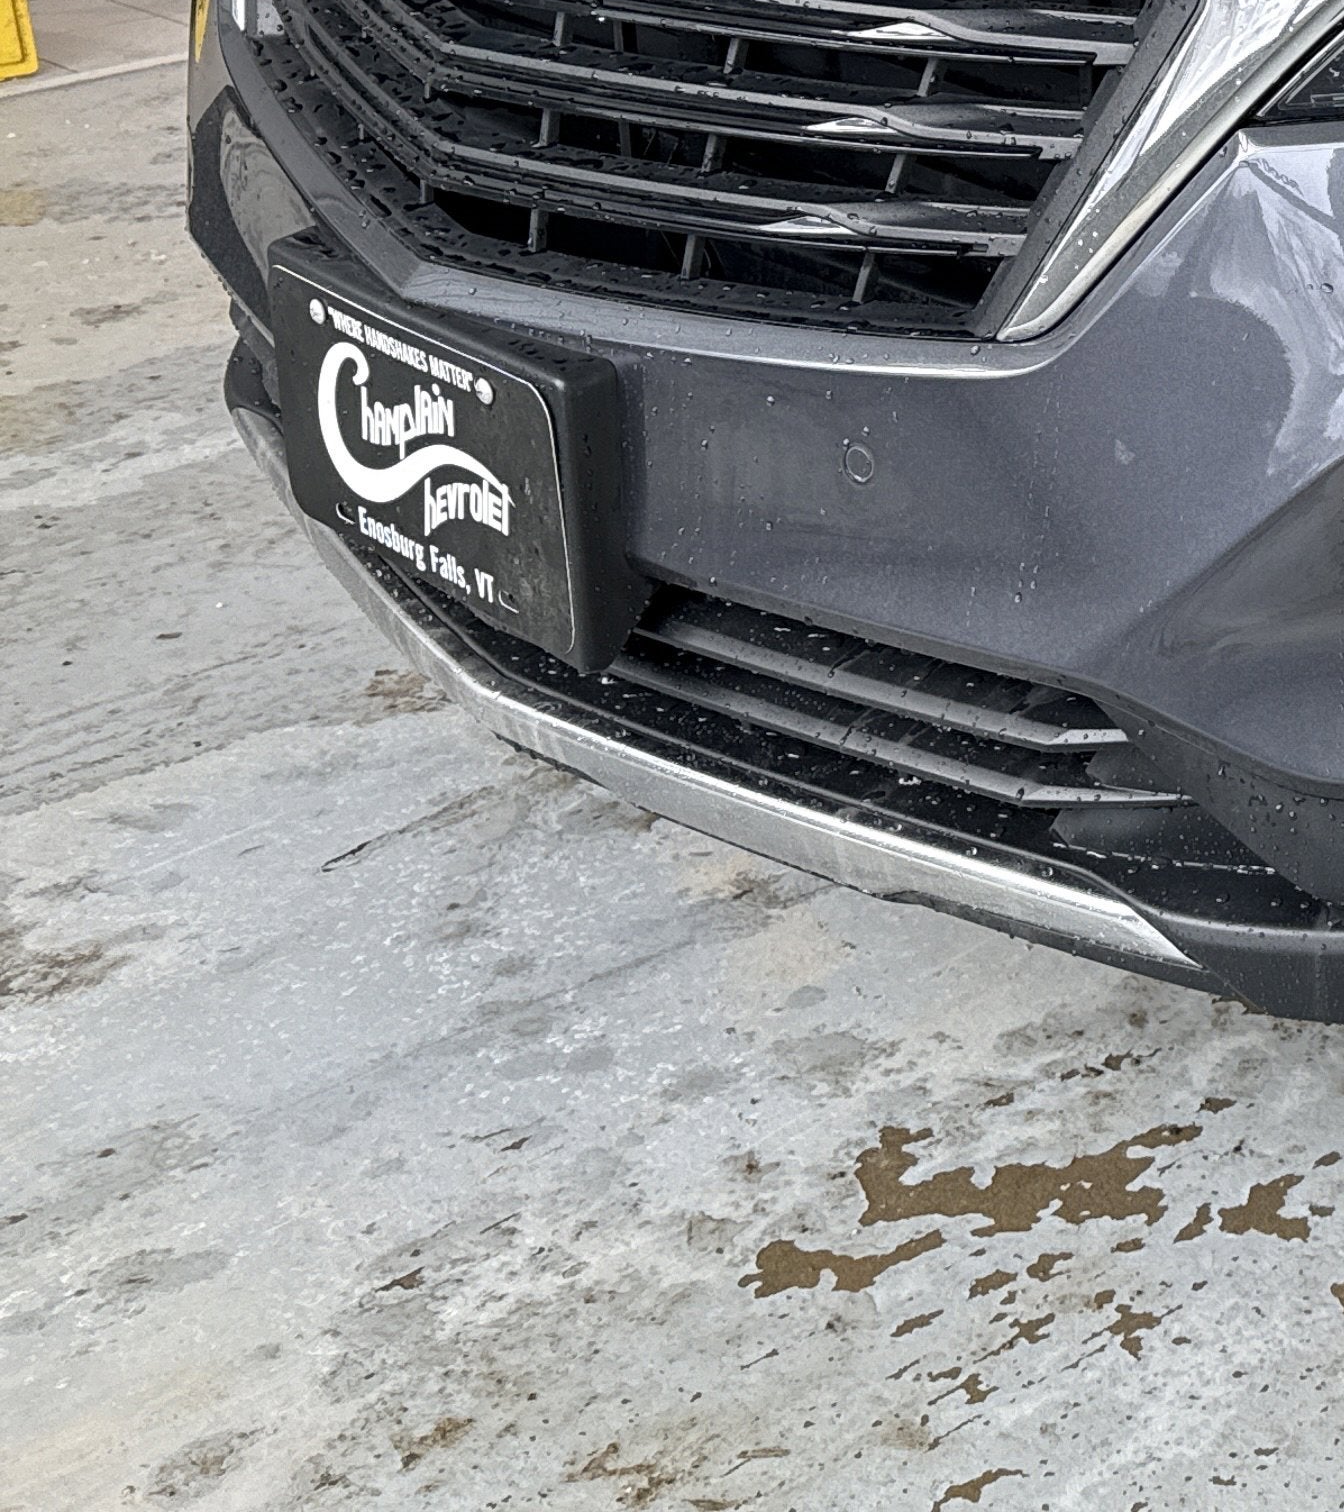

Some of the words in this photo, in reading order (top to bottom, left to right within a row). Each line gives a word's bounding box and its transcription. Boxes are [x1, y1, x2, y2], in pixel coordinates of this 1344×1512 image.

[363, 324, 430, 374] HANDSHAKES
[357, 505, 427, 572] Enosburg
[429, 543, 472, 596] Falls,
[474, 567, 495, 604] VT
